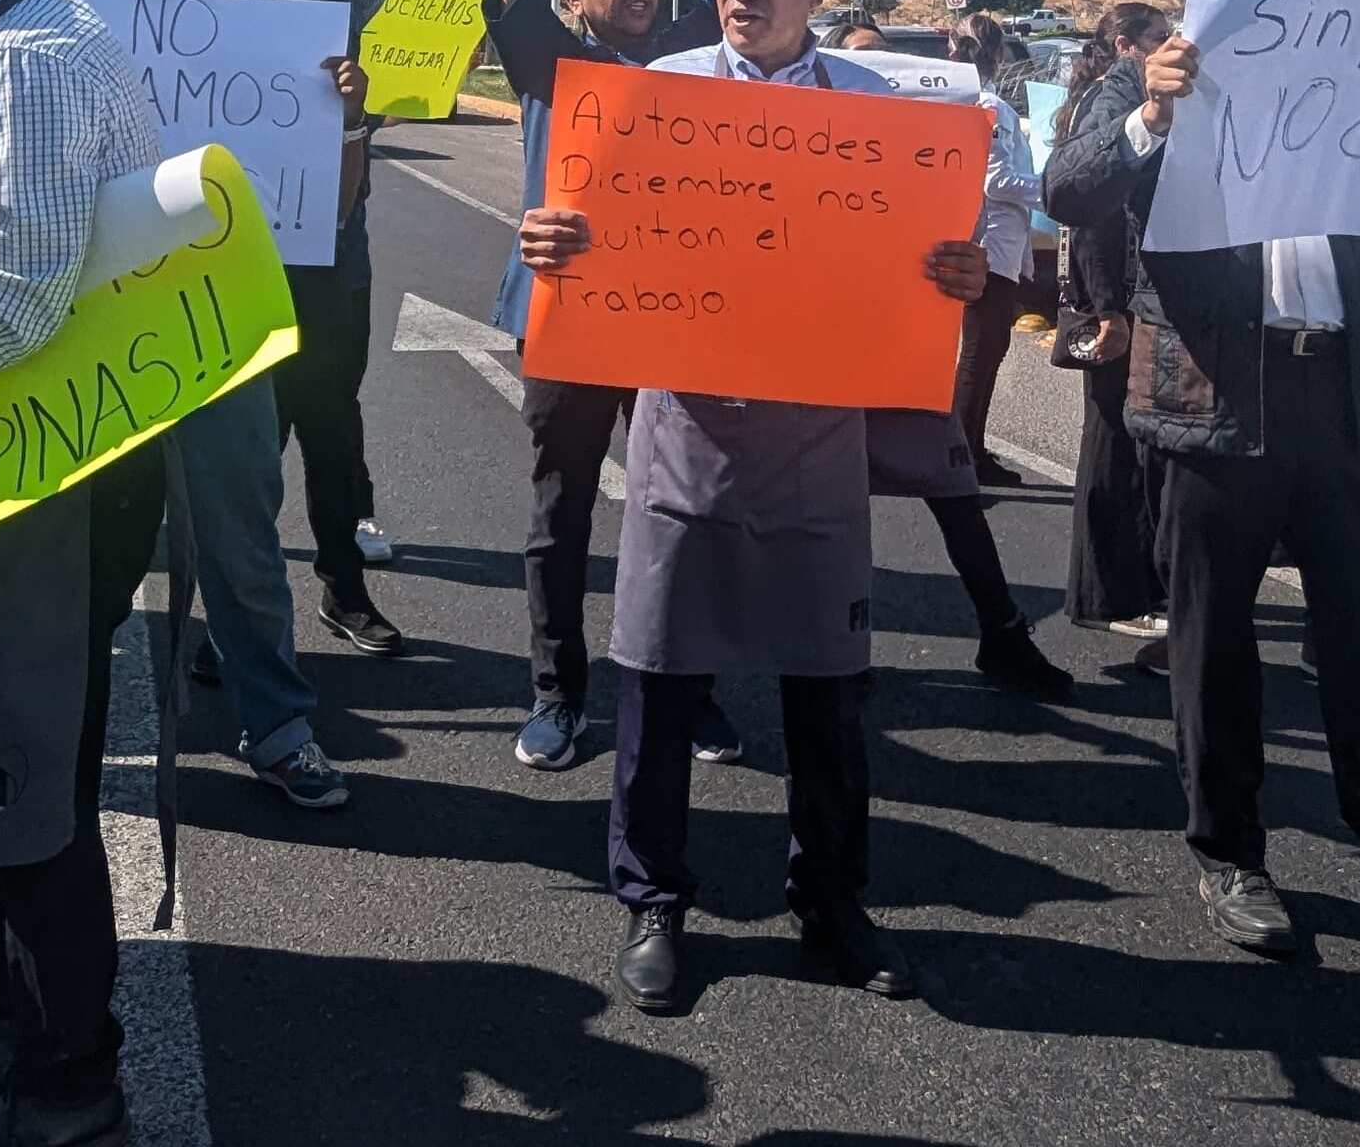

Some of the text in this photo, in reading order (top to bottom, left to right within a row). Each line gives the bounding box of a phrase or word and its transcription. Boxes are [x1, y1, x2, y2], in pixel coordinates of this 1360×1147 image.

[920, 76, 949, 88] en
[571, 91, 963, 170] Autoridades en
[1215, 77, 1336, 187] NO
[559, 155, 889, 213] Diciembre nos
[589, 211, 789, 250] uitan el
